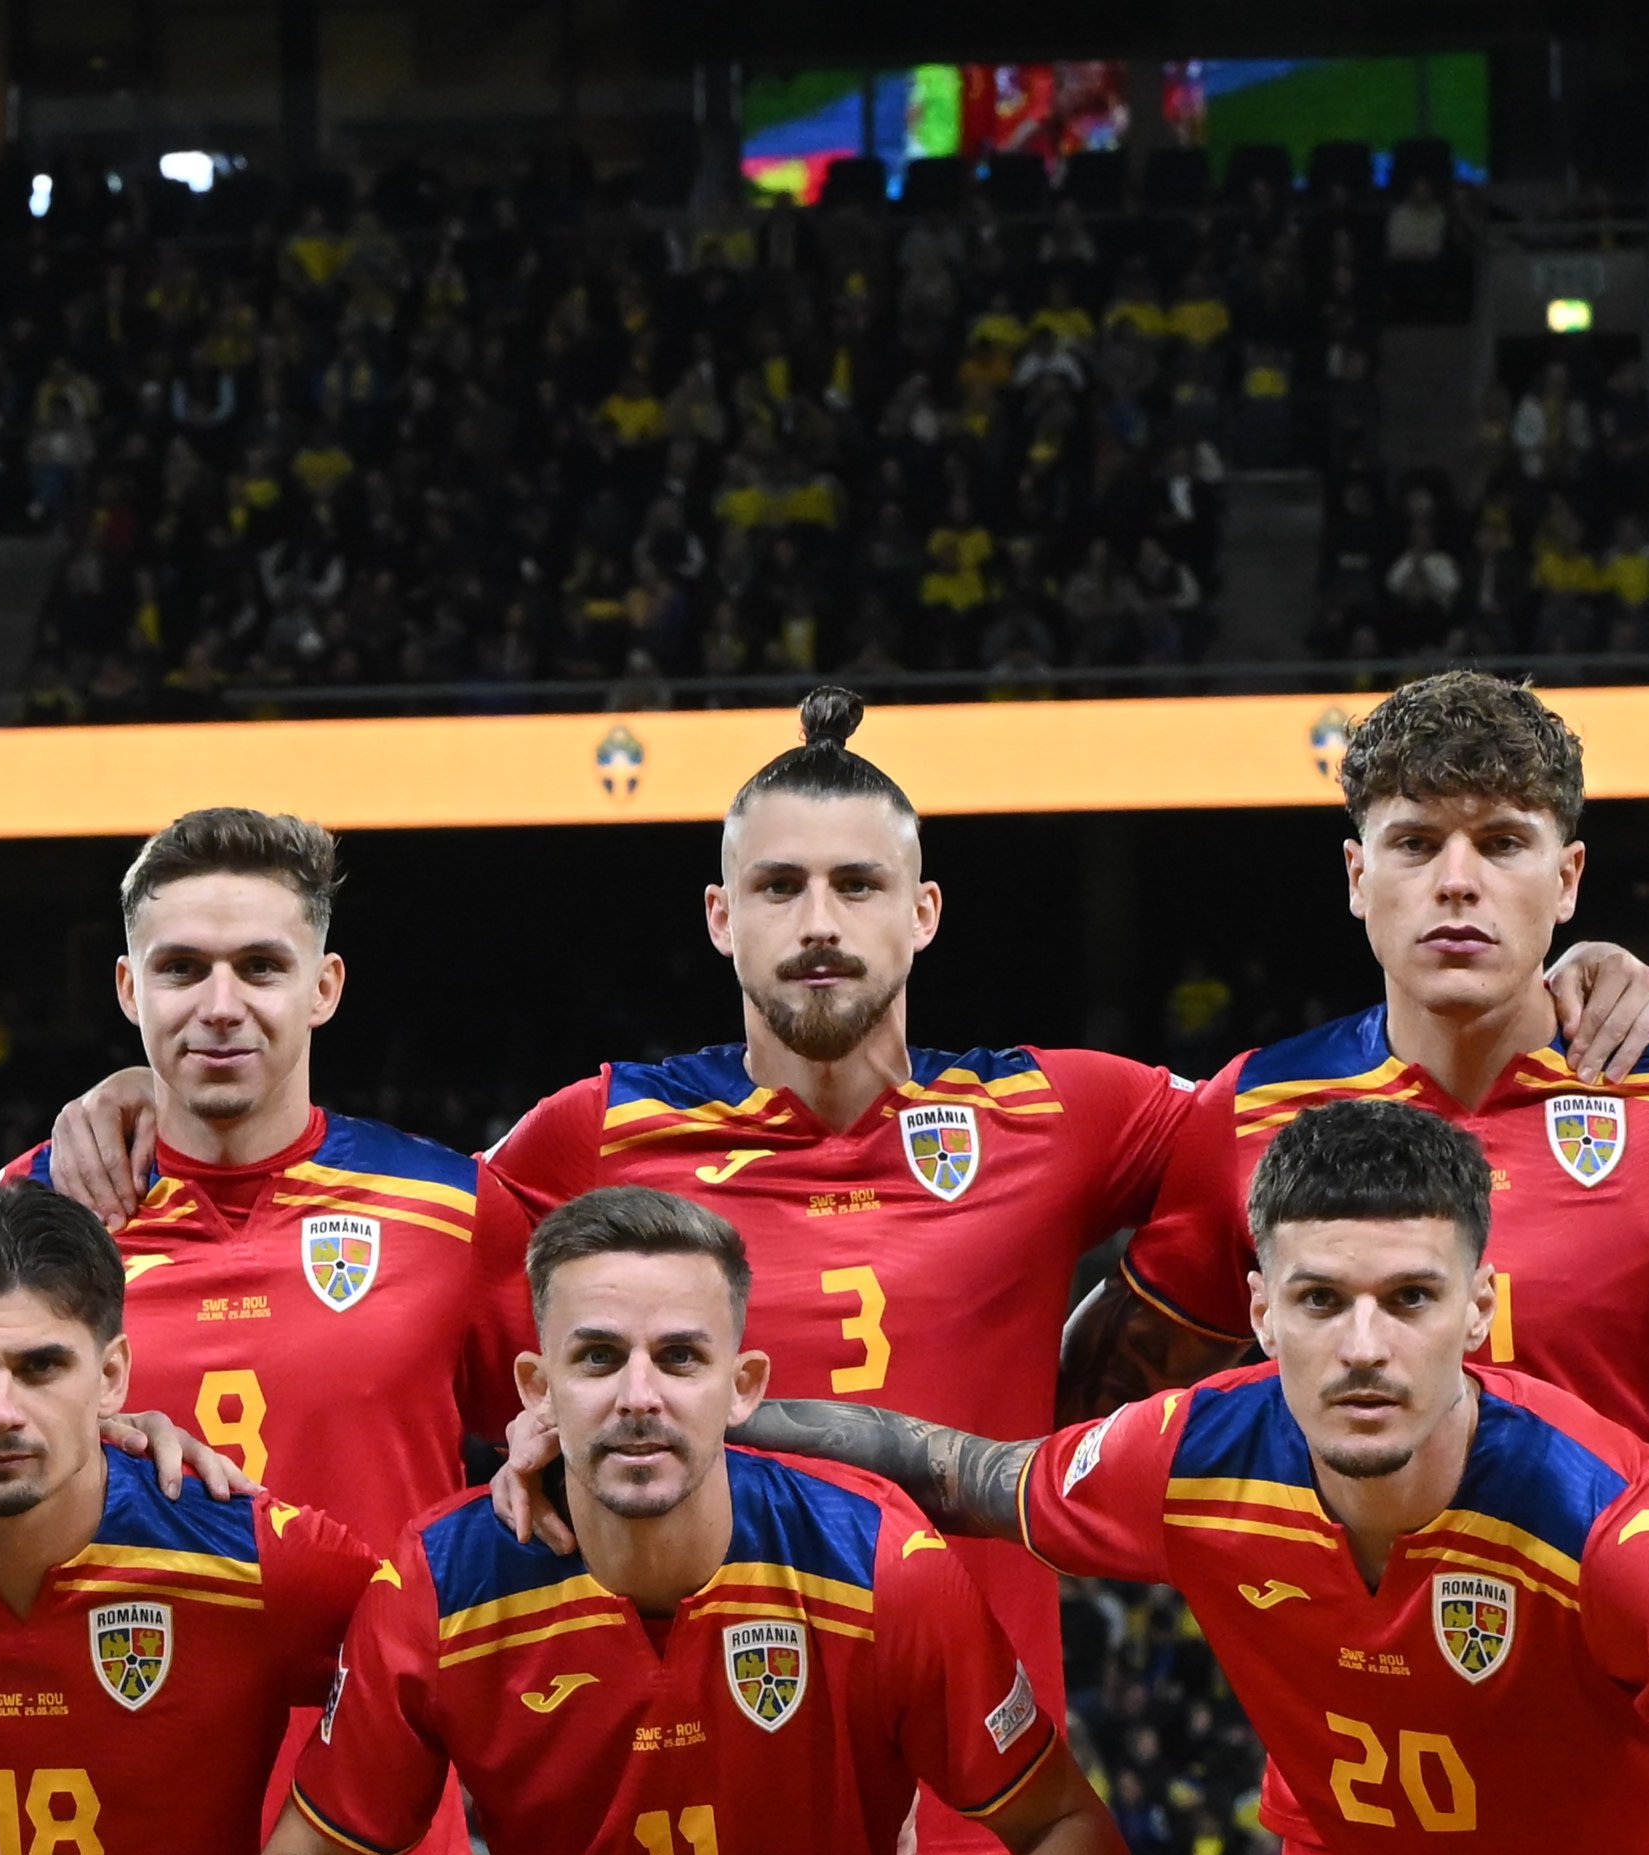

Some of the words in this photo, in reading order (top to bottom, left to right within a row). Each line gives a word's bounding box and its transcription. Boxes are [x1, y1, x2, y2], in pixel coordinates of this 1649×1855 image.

[907, 1108, 968, 1129] ROMÂNIA
[809, 1194, 835, 1208] SWE
[850, 1188, 874, 1203] ROU
[310, 1218, 372, 1237] ROMÂNIA
[202, 1299, 228, 1311] SWE
[243, 1296, 267, 1309] ROU
[821, 1266, 891, 1394] 3
[194, 1369, 268, 1485] 9
[1442, 1579, 1507, 1603] ROMÂNIA
[98, 1605, 163, 1627] ROMÂNIA
[732, 1625, 798, 1647] ROMÂNIA
[1340, 1647, 1365, 1662] SWE
[1379, 1654, 1403, 1666] ROU
[38, 1693, 63, 1706] ROU
[636, 1727, 662, 1740] SWE
[676, 1721, 701, 1736] ROU
[1325, 1711, 1476, 1832] 20
